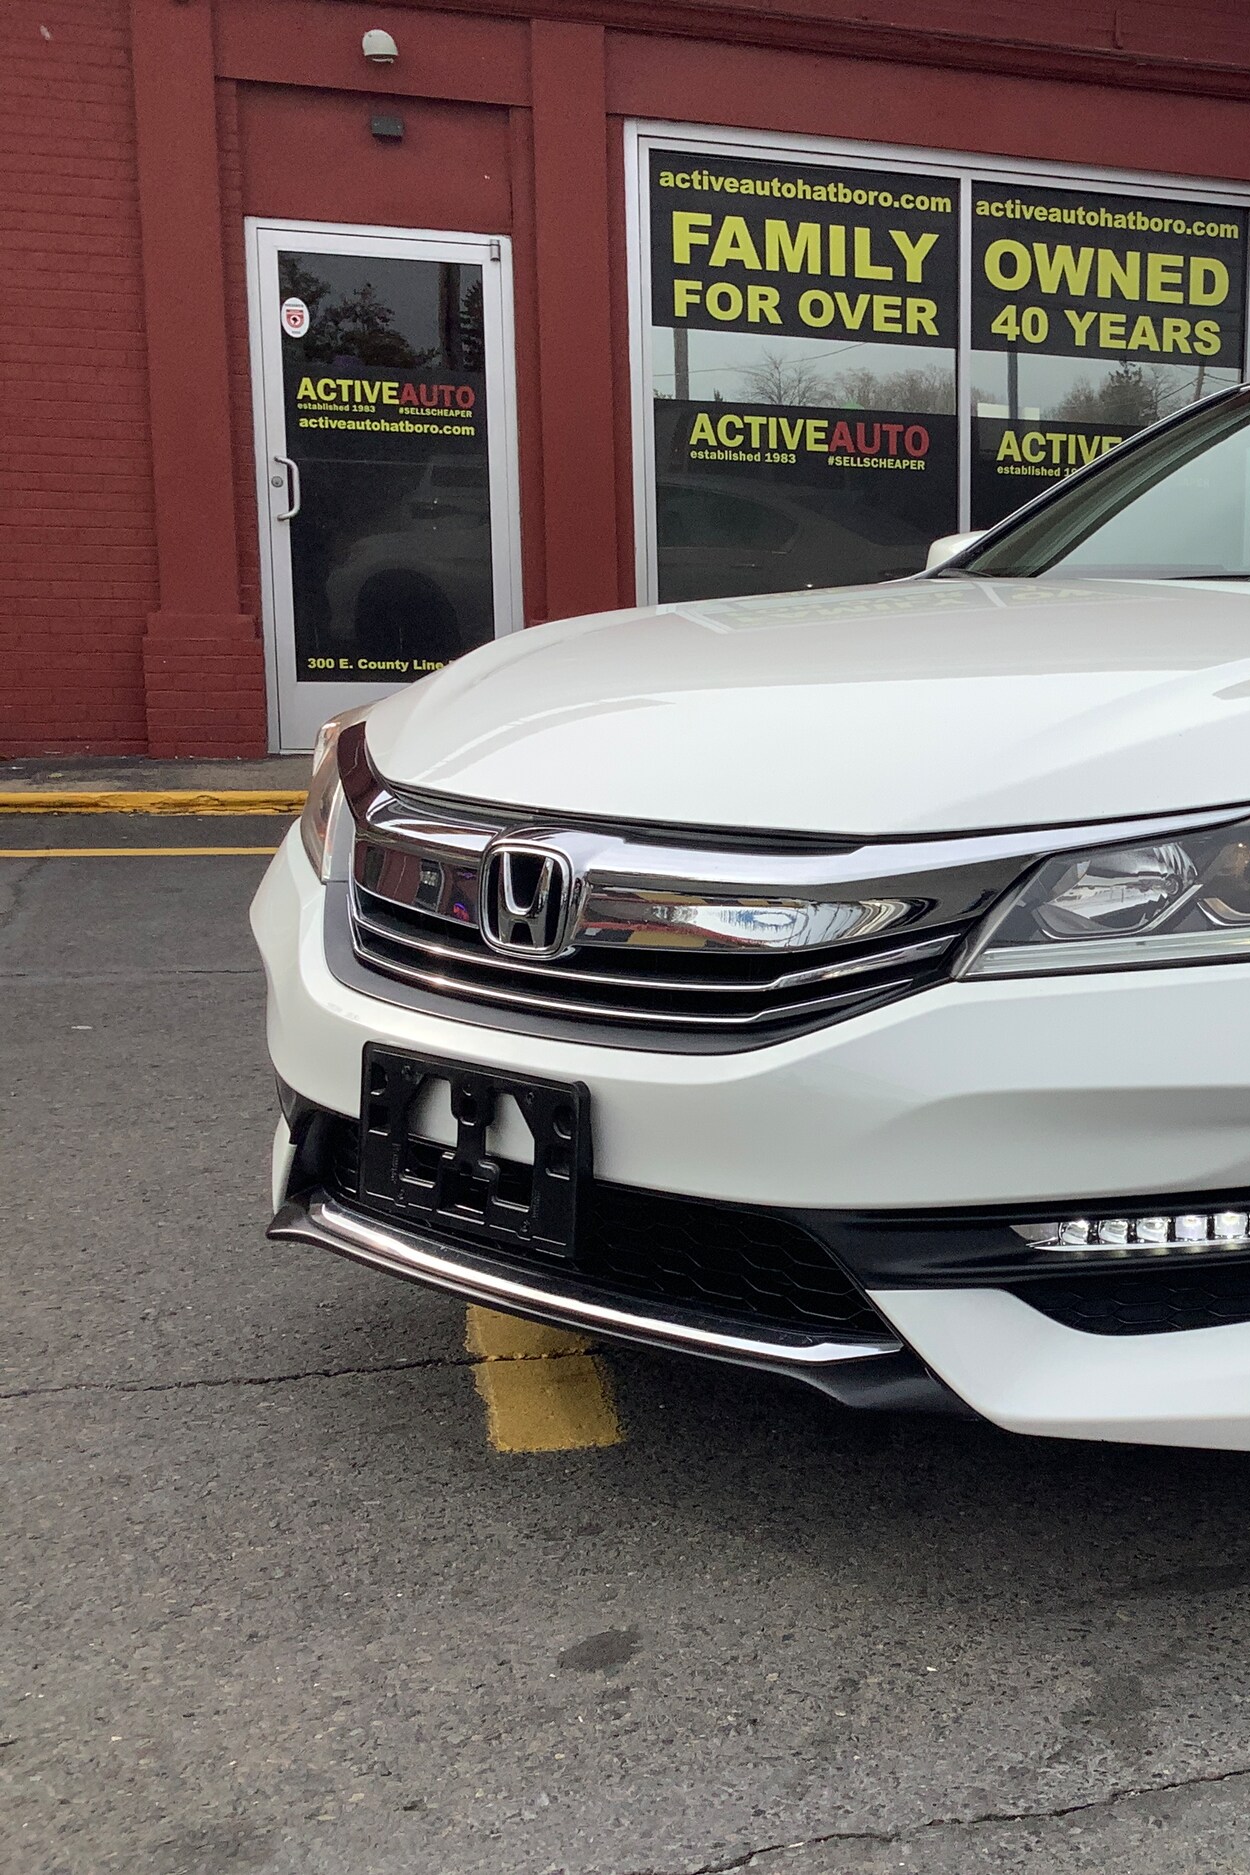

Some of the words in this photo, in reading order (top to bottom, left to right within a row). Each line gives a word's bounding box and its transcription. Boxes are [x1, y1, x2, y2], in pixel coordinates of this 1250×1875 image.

[658, 169, 952, 213] activeautohatboro.com
[975, 199, 1239, 239] activeautohatboro.com
[672, 210, 940, 283] FAMILY
[984, 238, 1230, 307] OWNED
[673, 279, 783, 325] FOR
[798, 289, 940, 336] OVER
[991, 304, 1049, 344] 40
[1064, 309, 1222, 356] YEARS
[297, 403, 350, 412] established
[352, 404, 376, 413] 1983
[399, 407, 473, 418] #SELLSCHEAPER
[299, 417, 476, 436] activeautohatboro.com
[690, 449, 761, 463] established
[764, 453, 797, 464] 1983
[828, 455, 926, 471] #SELLSCHEAPER
[997, 464, 1061, 477] established
[307, 657, 335, 669] 300
[338, 659, 354, 669] E.
[357, 659, 409, 672] County
[413, 660, 444, 671] Line
